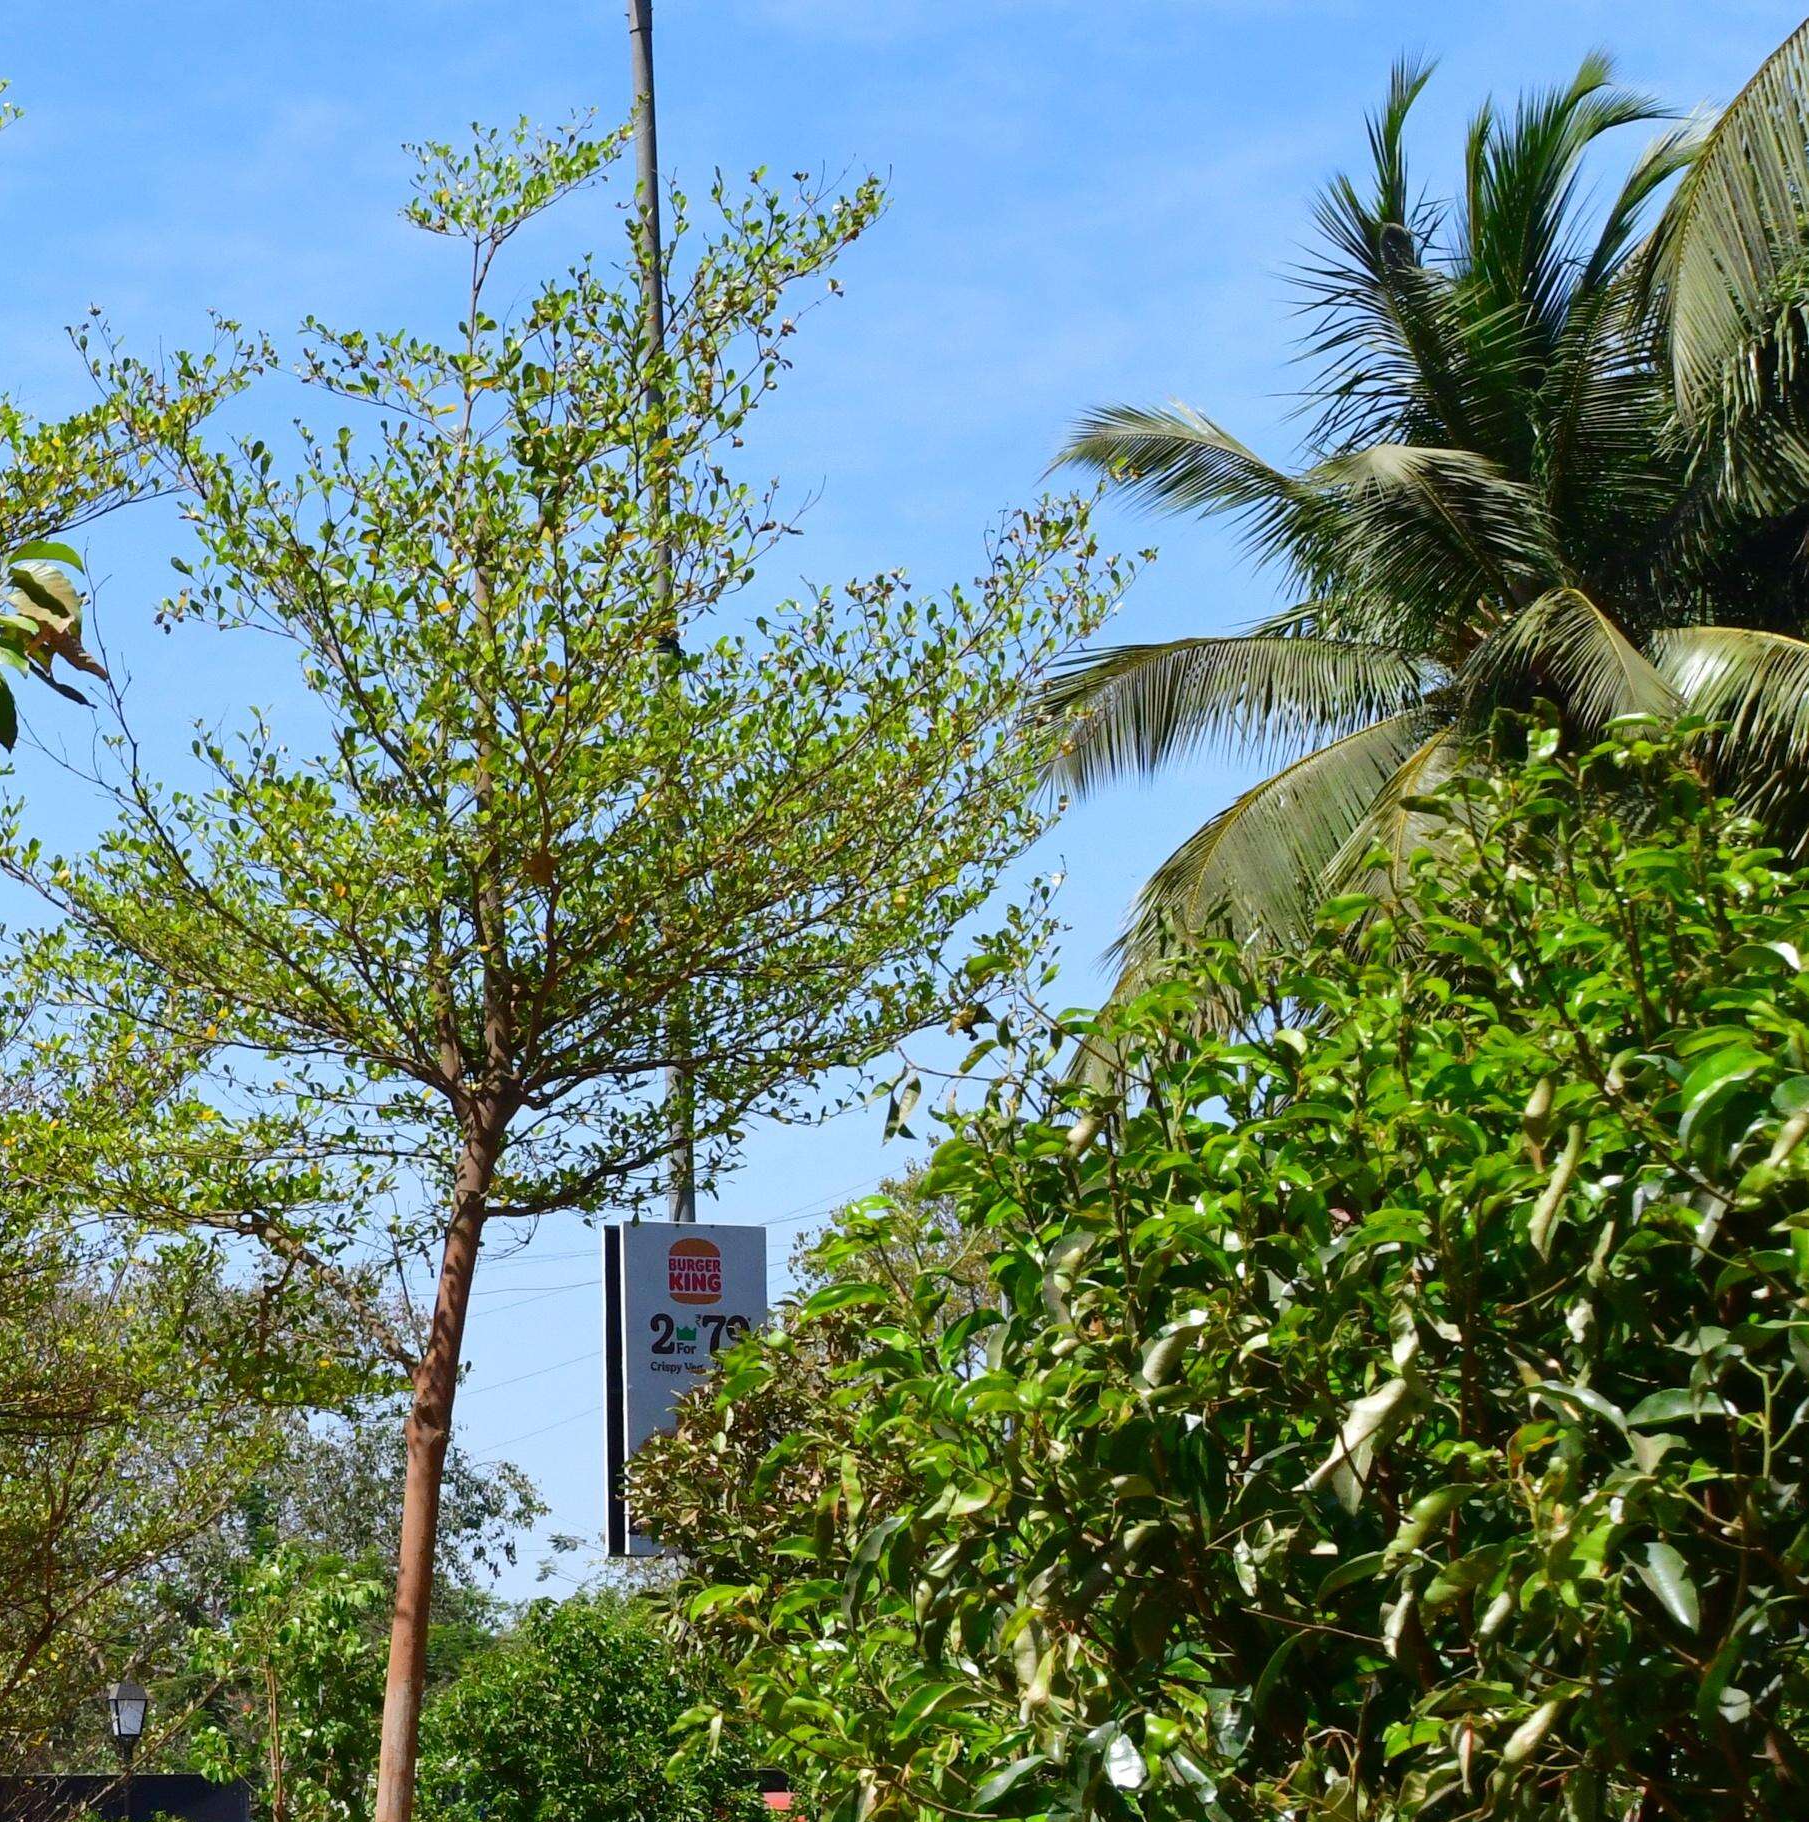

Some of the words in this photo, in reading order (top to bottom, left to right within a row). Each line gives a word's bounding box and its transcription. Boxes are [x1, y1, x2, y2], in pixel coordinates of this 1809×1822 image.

[668, 1258, 721, 1273] BURGER
[668, 1273, 722, 1292] KING
[650, 1313, 675, 1355] 2
[676, 1342, 698, 1355] For
[650, 1361, 683, 1375] Crispy
